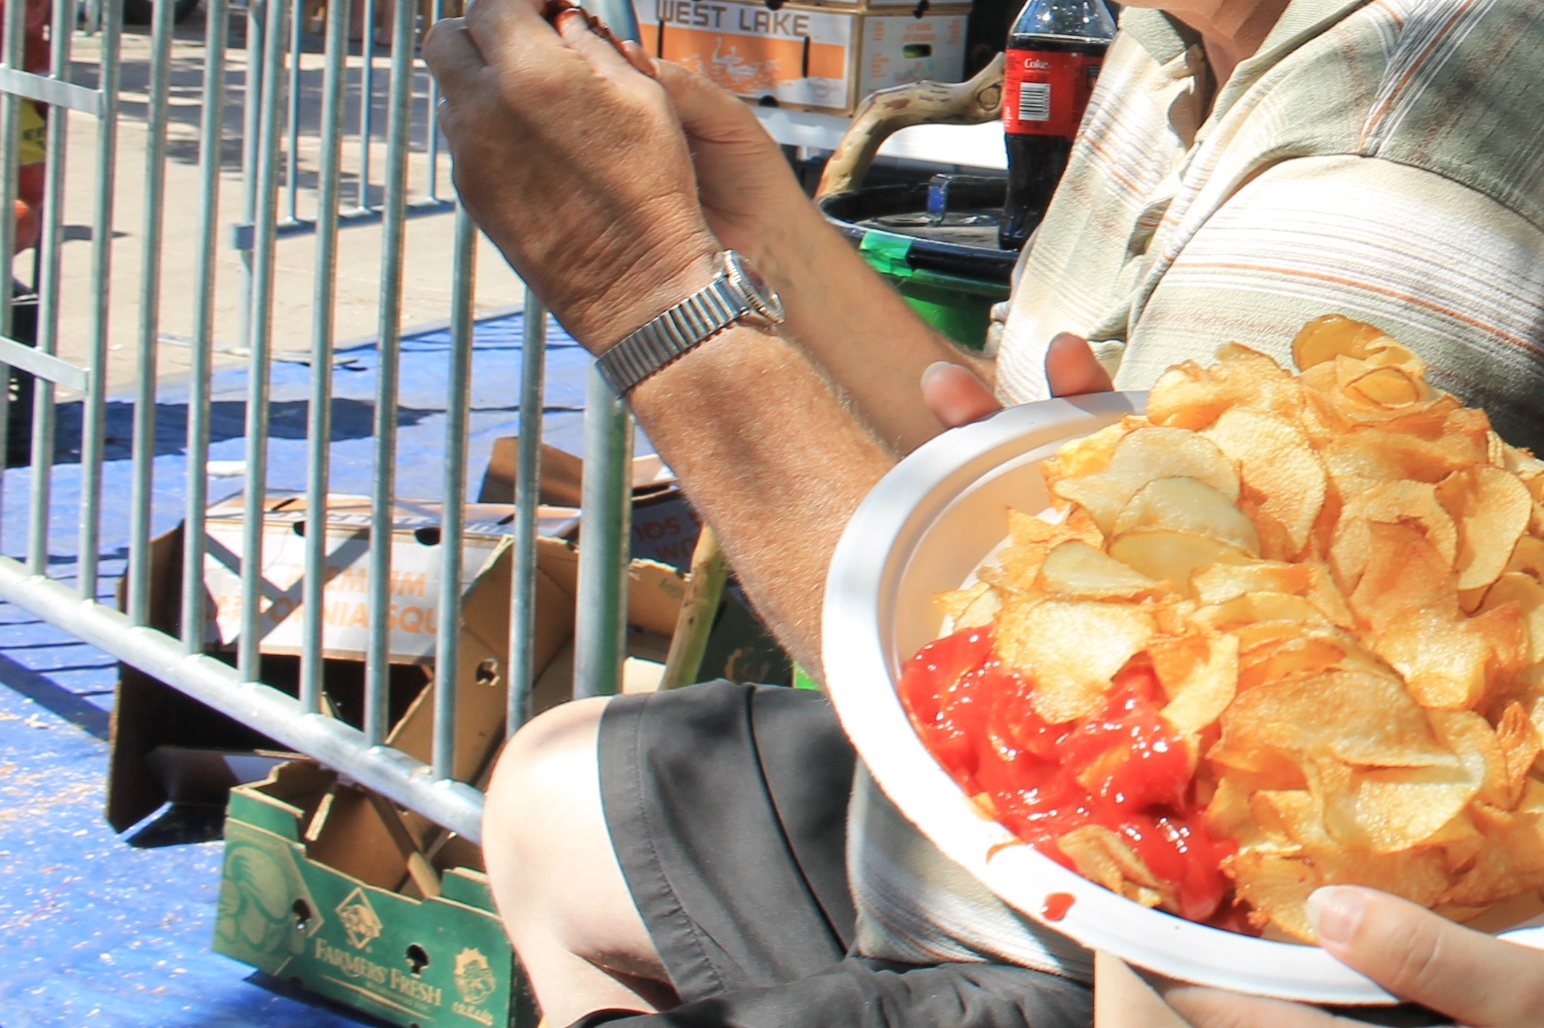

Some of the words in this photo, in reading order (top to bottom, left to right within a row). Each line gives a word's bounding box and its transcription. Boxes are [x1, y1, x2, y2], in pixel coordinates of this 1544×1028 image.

[656, 0, 727, 28] WEST
[740, 8, 810, 36] LAKE
[1024, 58, 1048, 69] Coke
[316, 938, 387, 984] FARMERS
[390, 968, 443, 1007] FRESH
